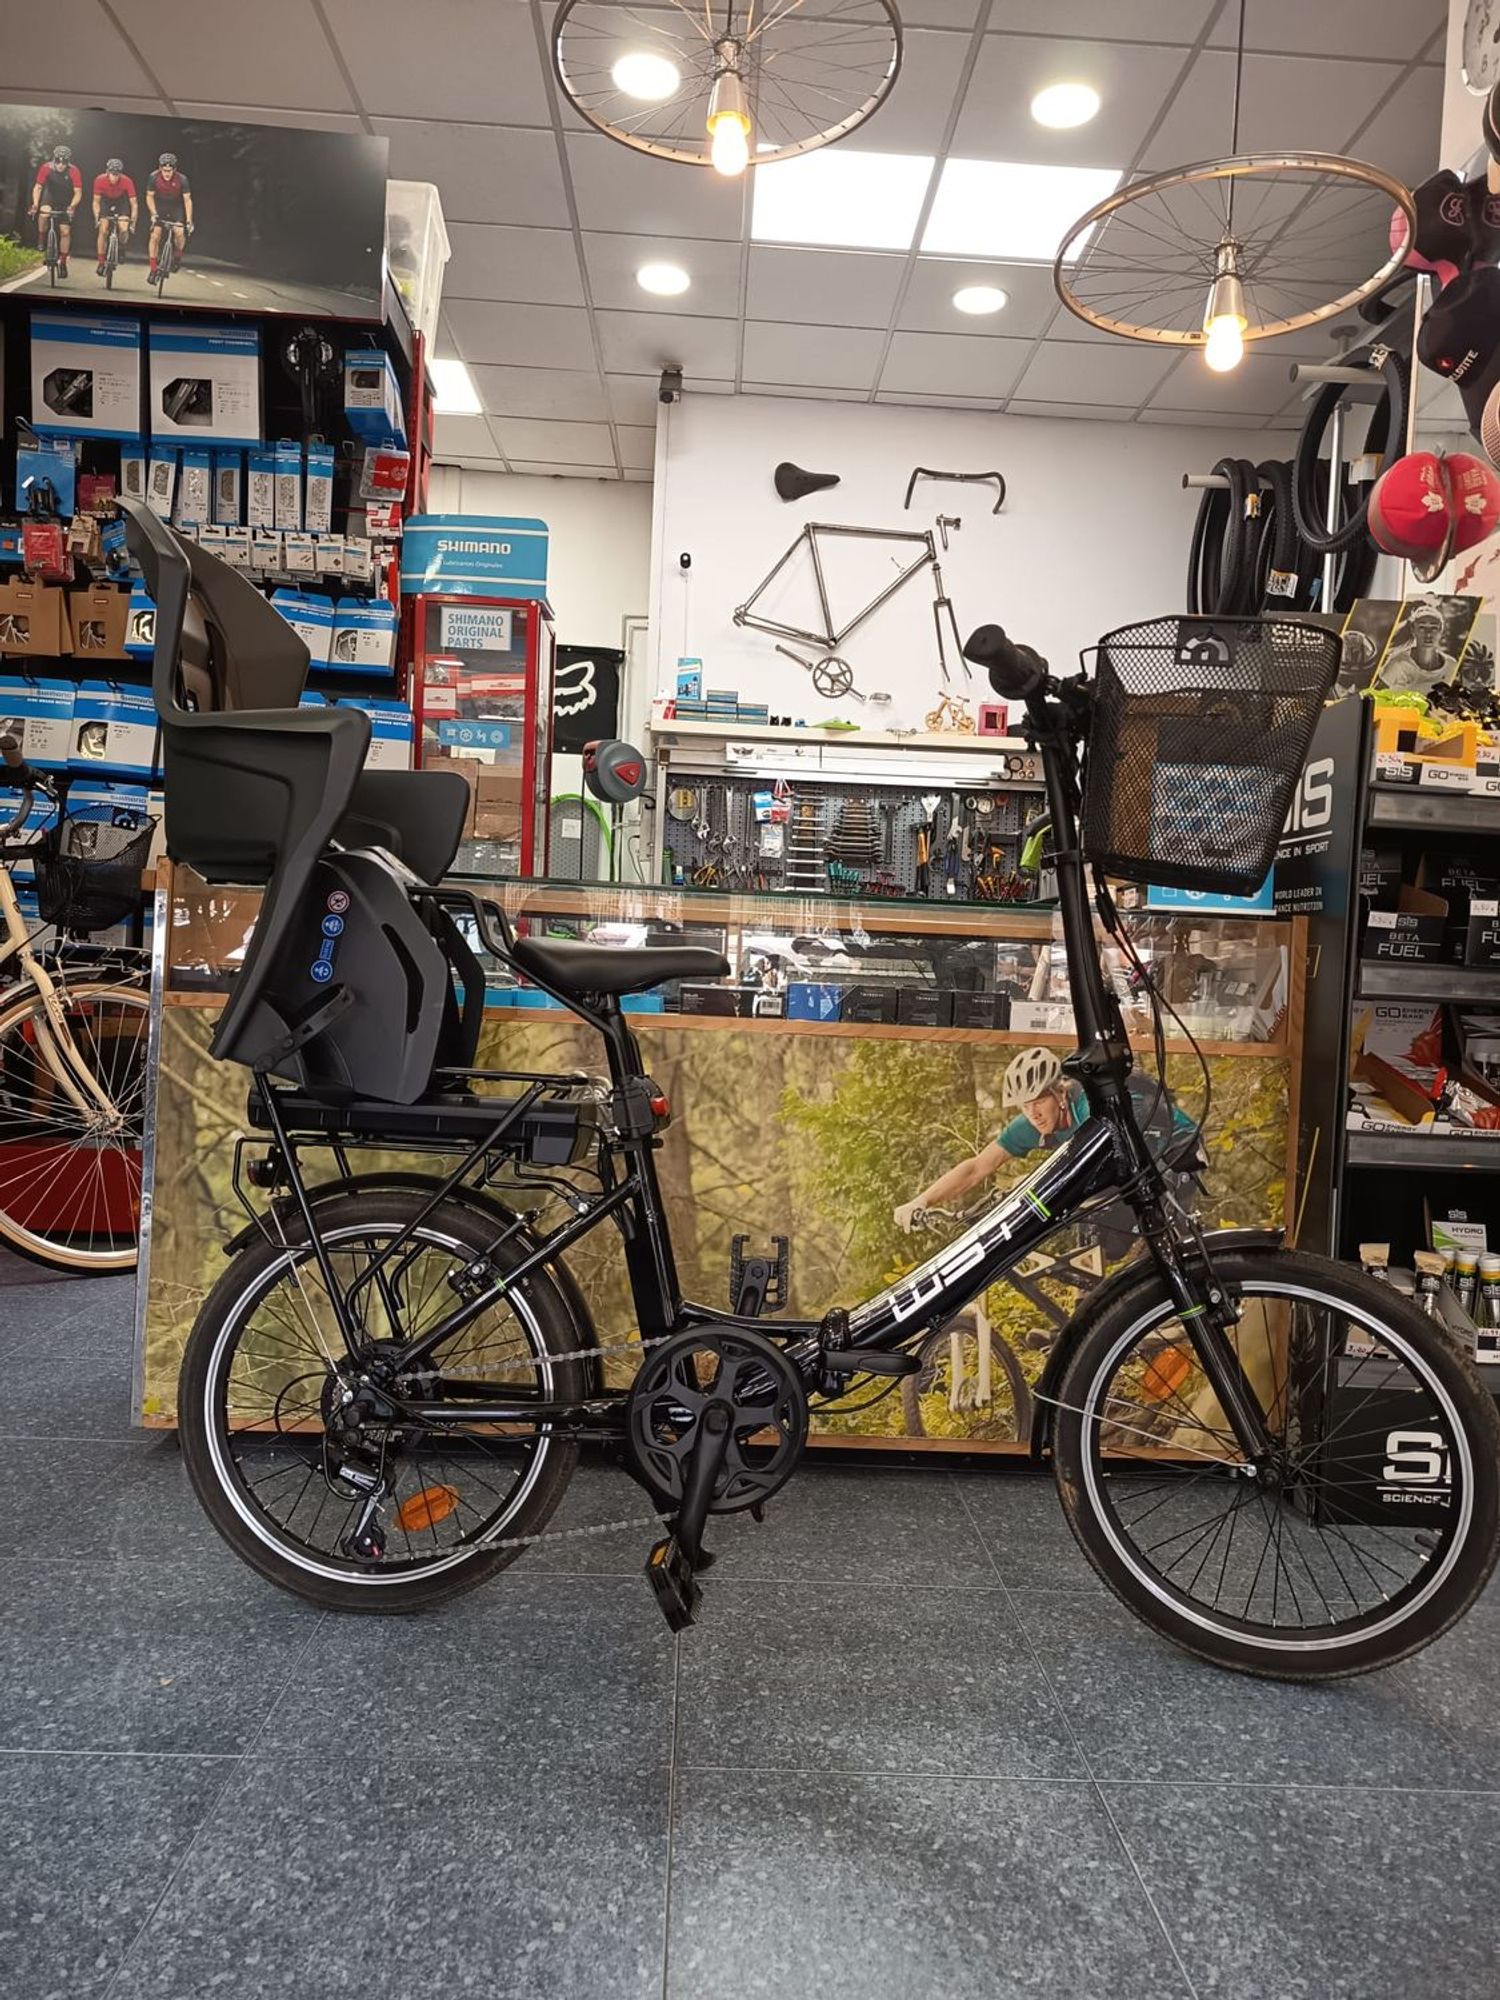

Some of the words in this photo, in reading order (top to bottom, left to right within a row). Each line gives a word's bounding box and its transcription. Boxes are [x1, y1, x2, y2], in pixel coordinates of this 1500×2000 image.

[437, 540, 511, 554] SHIMANO
[448, 614, 504, 626] SHIMANO
[448, 625, 504, 638] ORIGINAL
[447, 636, 484, 648] PARTS
[1427, 769, 1449, 780] GO
[1485, 780, 1500, 792] G
[1293, 846, 1302, 856] IN
[1305, 841, 1330, 854] SPORT
[1275, 890, 1292, 899] WORLD
[1293, 887, 1315, 898] LEADER
[1389, 932, 1420, 941] BETA
[1377, 943, 1425, 958] FUEL
[1376, 1007, 1401, 1018] GO
[1361, 1121, 1386, 1131] GO
[1452, 1227, 1484, 1235] HYDRO
